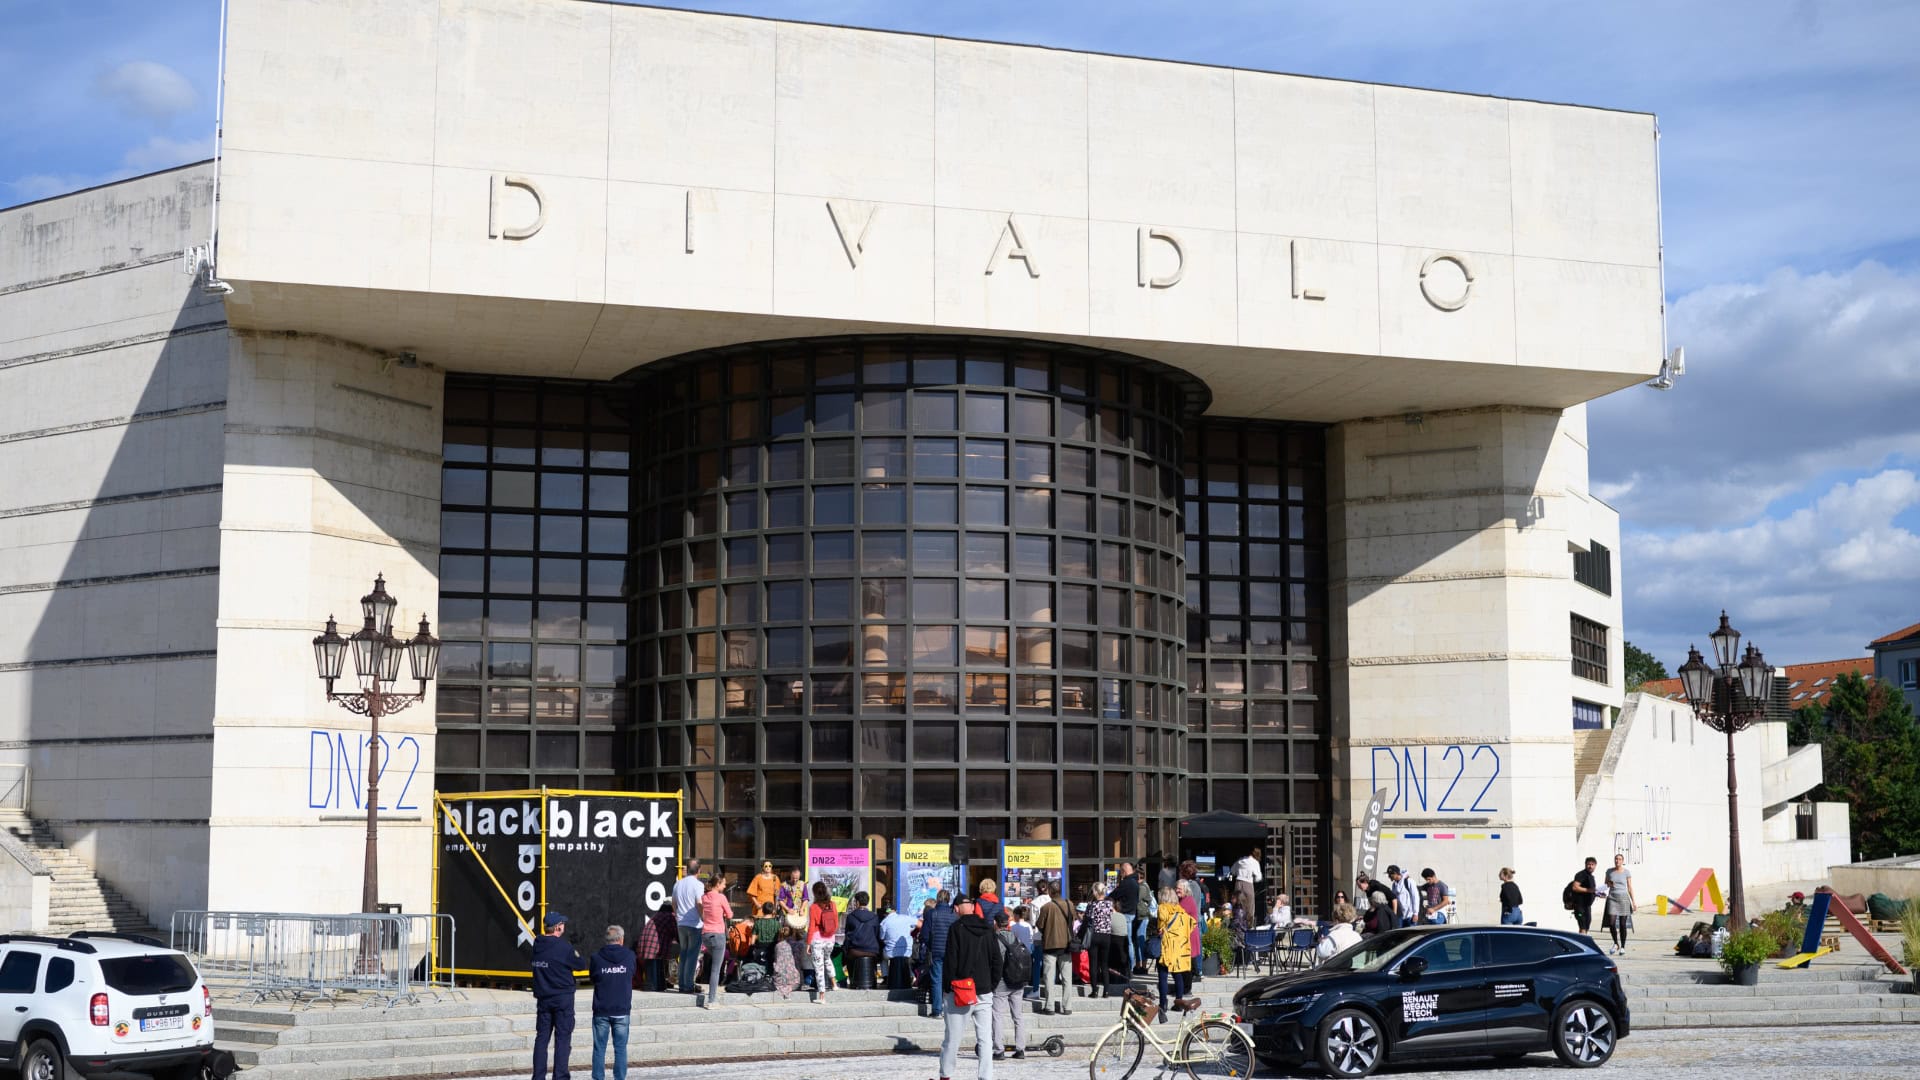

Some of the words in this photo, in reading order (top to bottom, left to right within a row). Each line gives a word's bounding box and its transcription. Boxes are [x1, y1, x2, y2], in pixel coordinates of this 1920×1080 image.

[489, 174, 1475, 312] DIVADLO
[309, 730, 420, 809] DN22
[1371, 745, 1500, 812] DN22
[444, 800, 542, 835] black
[549, 800, 673, 838] black
[1363, 801, 1381, 870] offee
[549, 842, 605, 852] empathy
[904, 852, 928, 860] DN22
[812, 856, 836, 865] DN22
[1007, 855, 1030, 863] DN22
[517, 844, 542, 948] box
[644, 847, 674, 925] bo
[601, 965, 627, 974] HASIČI
[1402, 994, 1440, 1003] RENAULT
[146, 1009, 180, 1017] DUSTER
[1403, 1009, 1433, 1018] E-TECH
